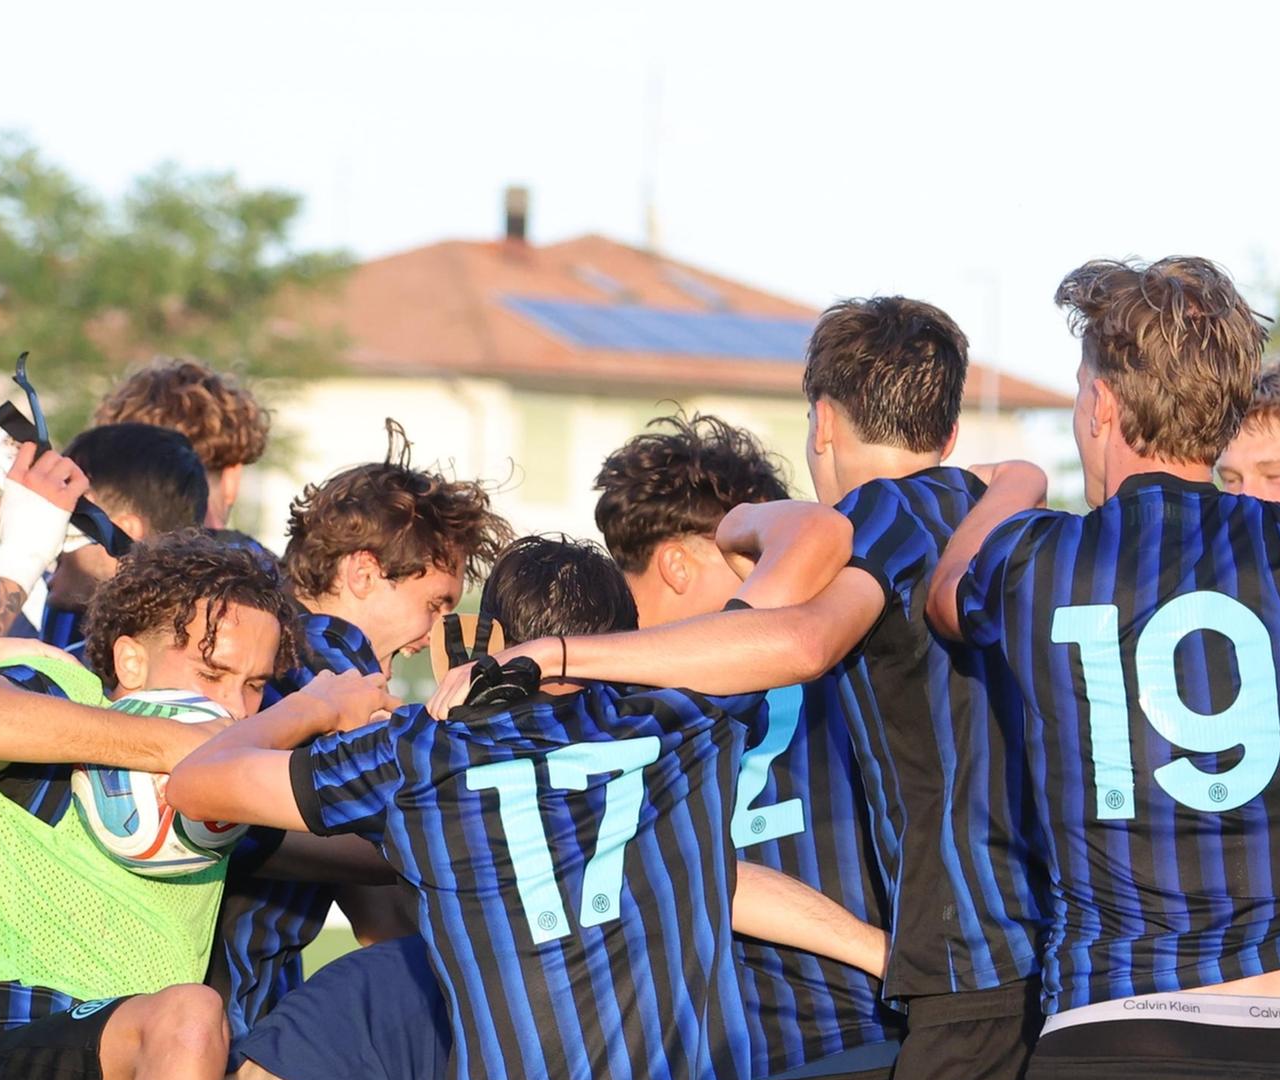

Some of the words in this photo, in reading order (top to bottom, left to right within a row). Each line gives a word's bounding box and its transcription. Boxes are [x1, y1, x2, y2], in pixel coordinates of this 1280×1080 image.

[465, 736, 661, 945] 17
[1123, 999, 1168, 1011] Calvin
[1169, 1001, 1201, 1014] Klein
